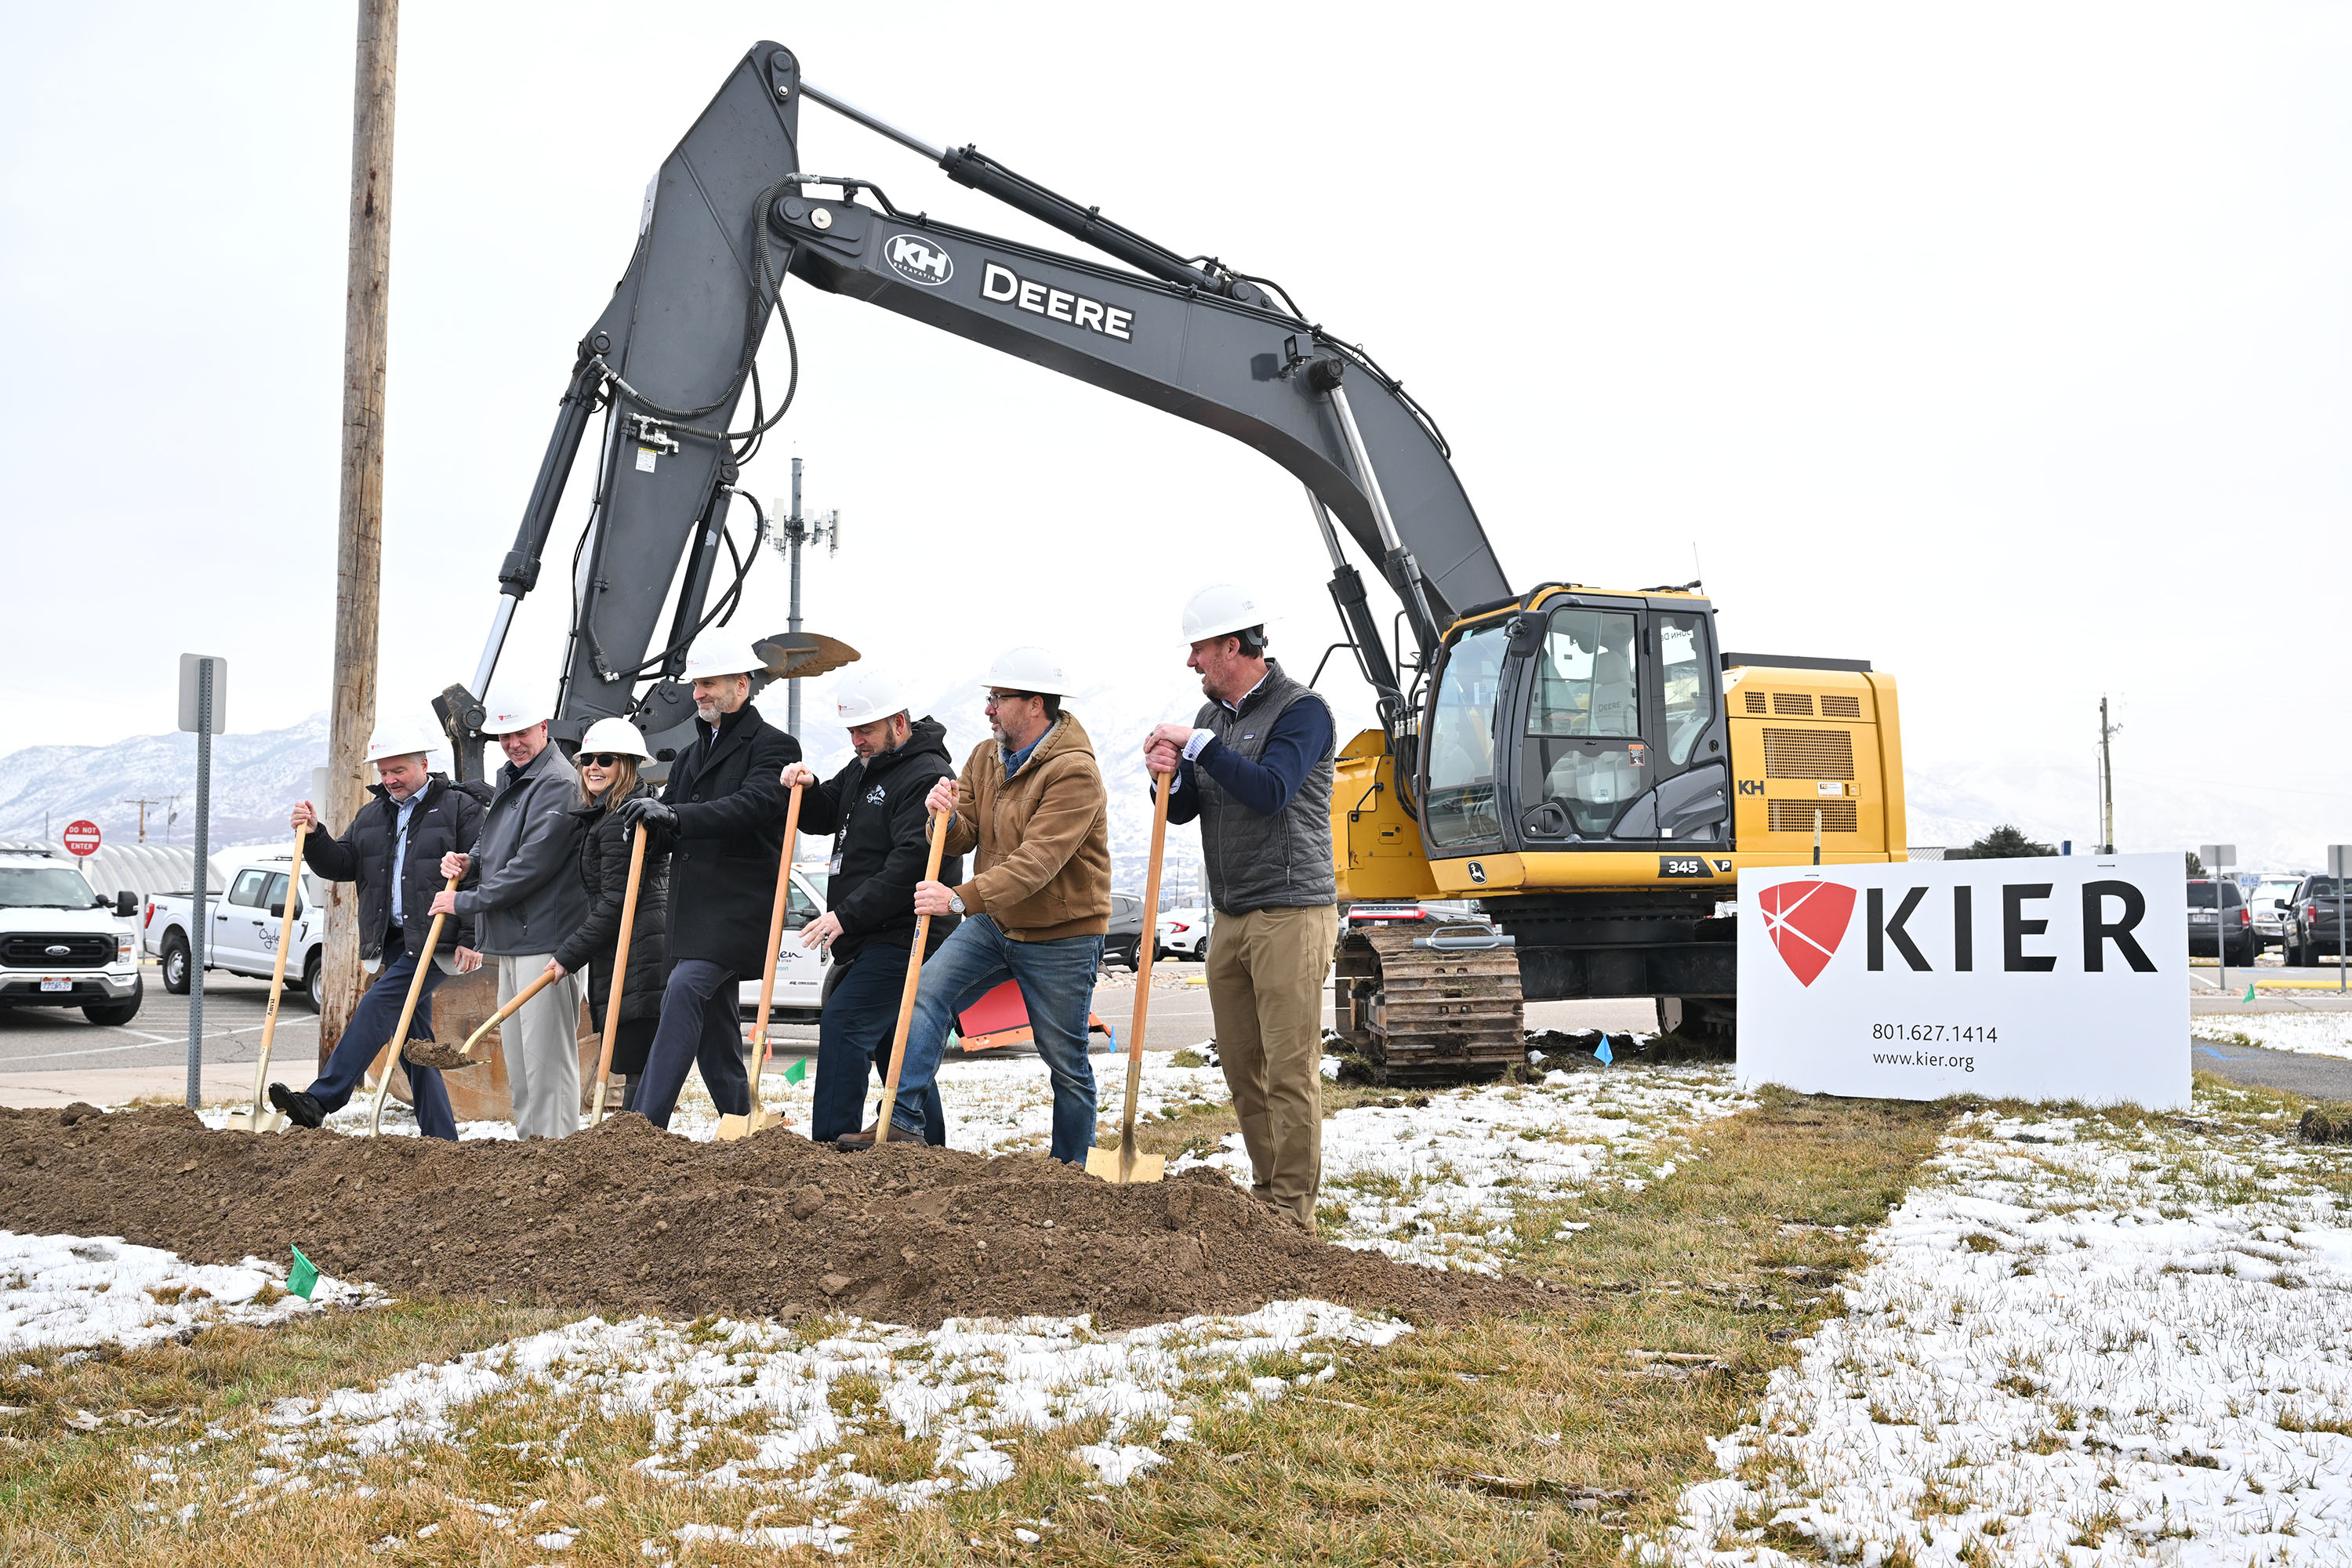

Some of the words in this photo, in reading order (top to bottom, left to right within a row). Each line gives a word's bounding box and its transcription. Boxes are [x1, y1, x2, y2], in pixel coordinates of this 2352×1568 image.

[893, 237, 947, 278] KH
[893, 262, 941, 283] EXCAVATION
[982, 263, 1132, 340] DEERE
[1598, 701, 1621, 713] DEERE
[1738, 779, 1765, 795] KH
[71, 842, 93, 851] ENTER
[1668, 860, 1699, 874] 345
[1721, 861, 1731, 871] P
[1866, 880, 2159, 973] KIER
[259, 927, 280, 949] Ogde
[267, 998, 275, 1017] Anvil
[1872, 1023, 1998, 1044] 801.627.1414
[1872, 1051, 1975, 1073] www.kier.org
